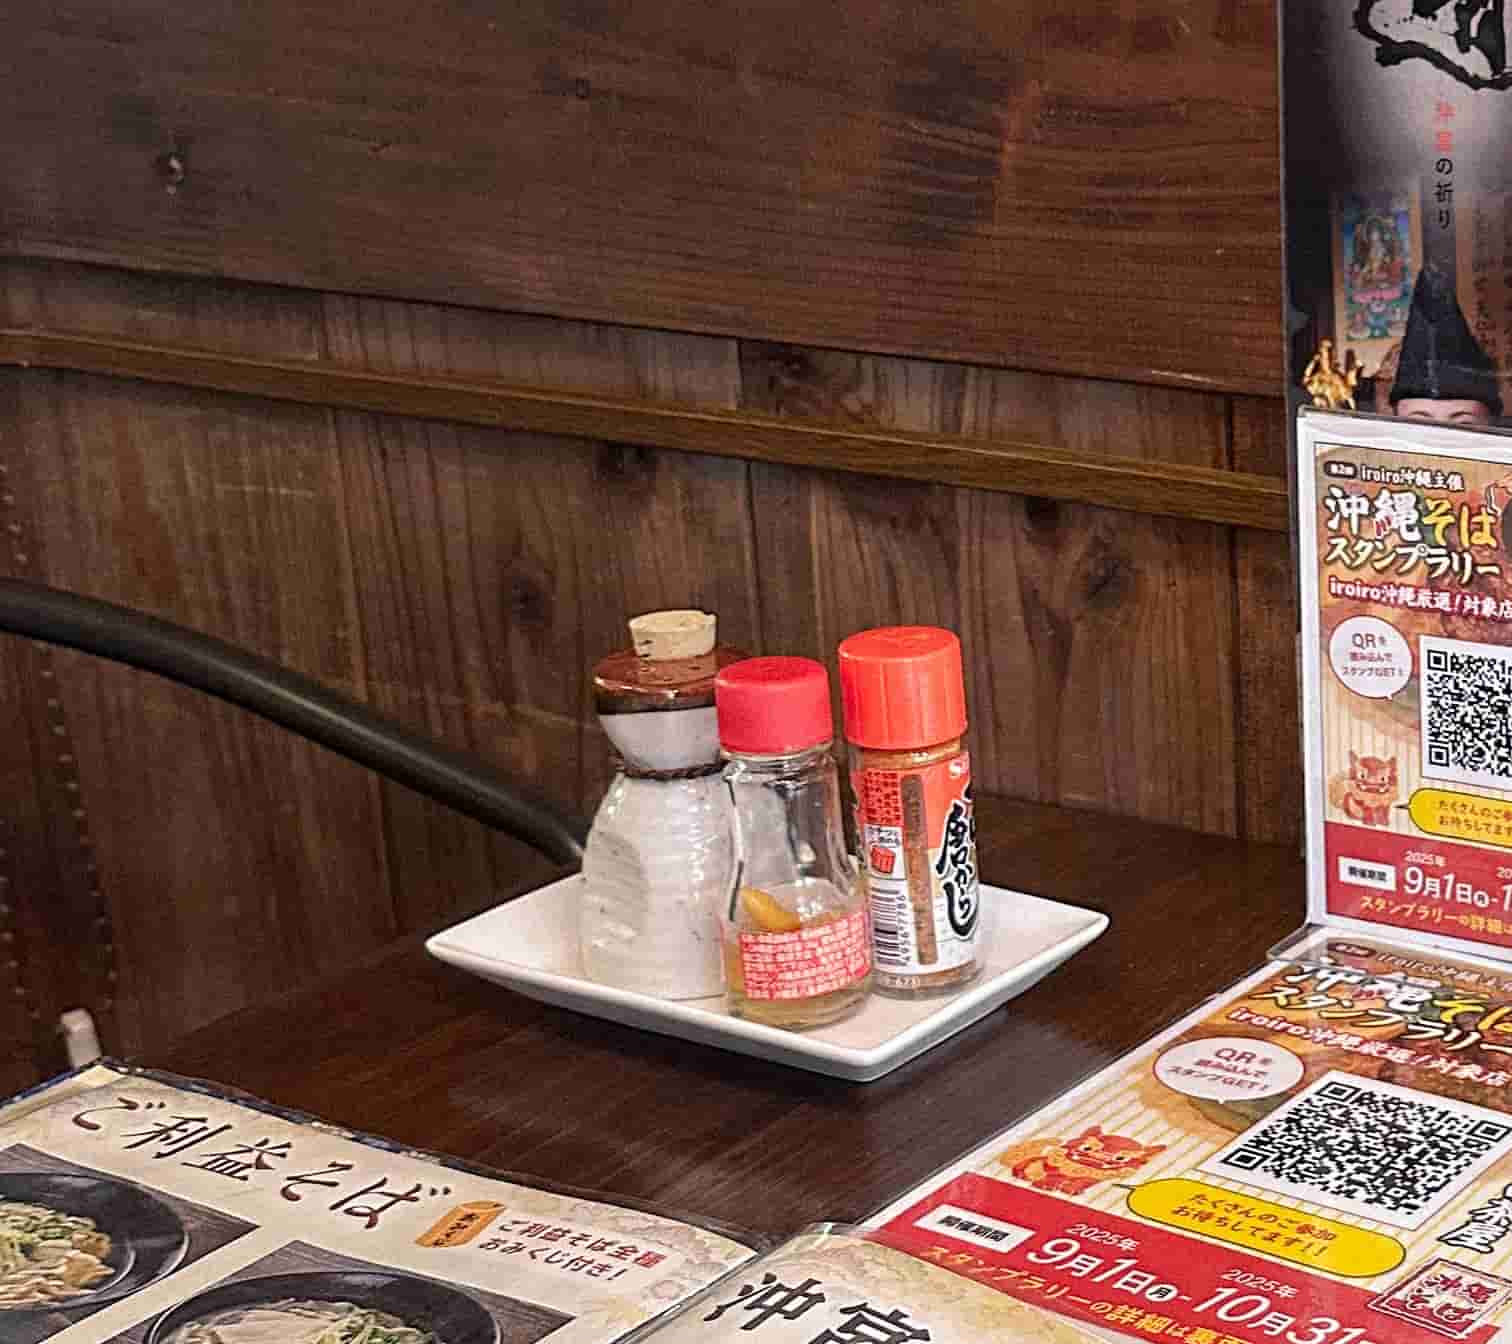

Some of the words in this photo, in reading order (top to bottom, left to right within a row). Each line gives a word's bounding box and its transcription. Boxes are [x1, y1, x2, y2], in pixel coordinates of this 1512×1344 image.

[1324, 485, 1498, 548] 沖縄そば
[1326, 537, 1501, 584] スタンプラリー
[72, 1096, 451, 1230] ご利益そば
[1065, 1223, 1141, 1251] 2025年
[1221, 1268, 1300, 1299] 2025年
